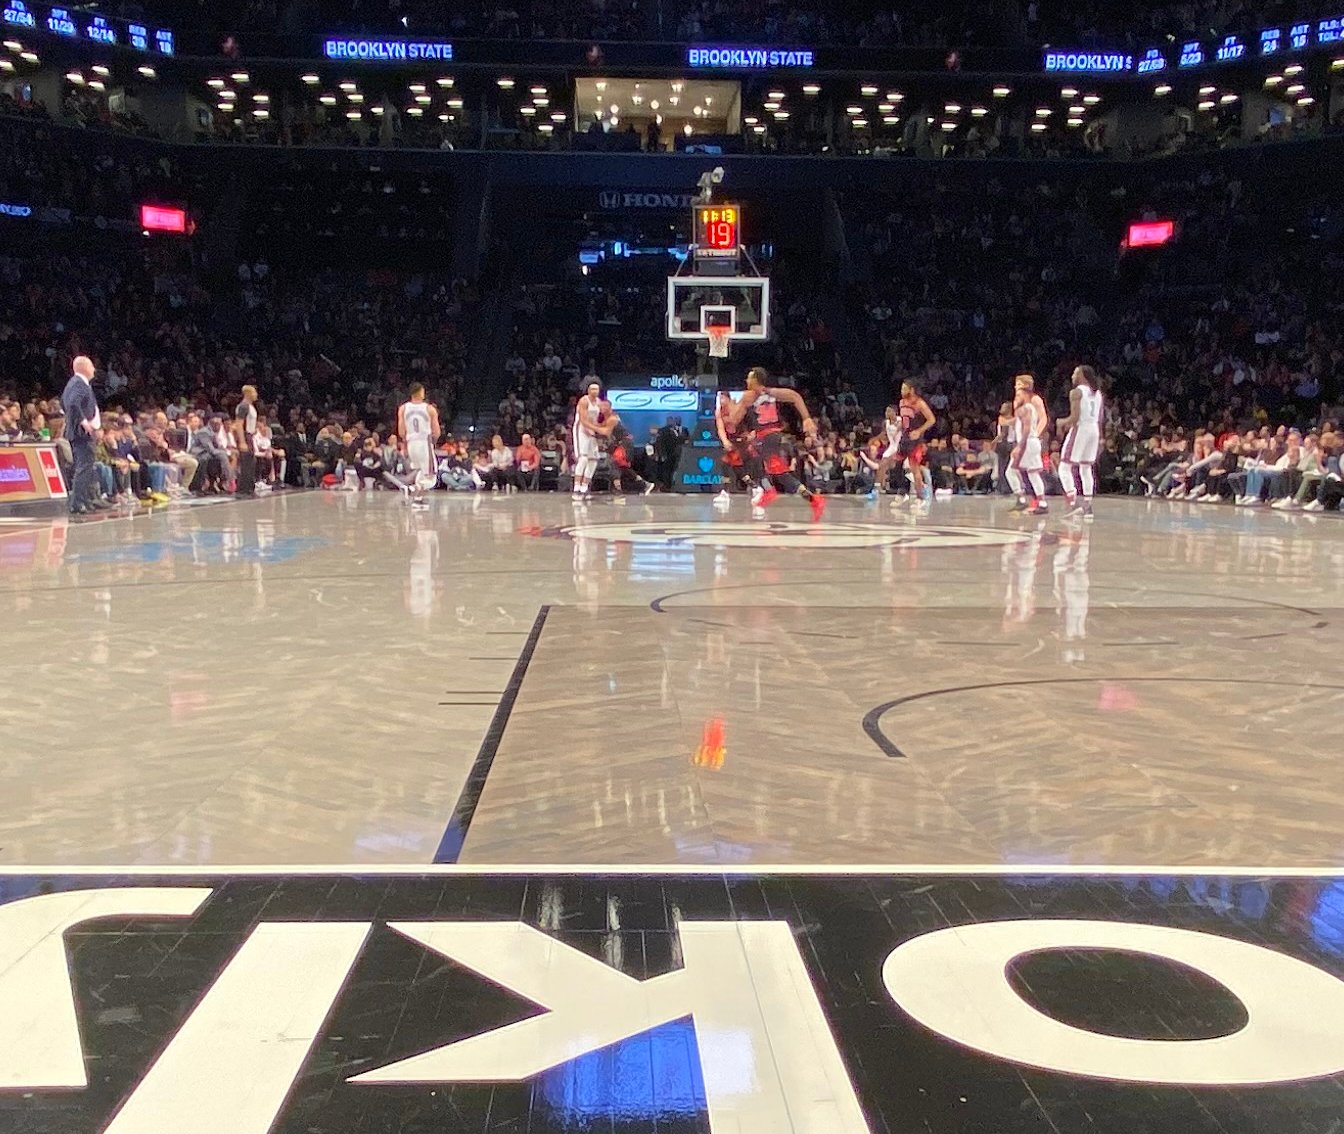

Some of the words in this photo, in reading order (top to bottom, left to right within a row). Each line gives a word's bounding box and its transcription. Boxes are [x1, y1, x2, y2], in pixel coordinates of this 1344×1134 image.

[326, 41, 406, 58] BROOKLYN
[408, 44, 453, 59] STATE
[689, 49, 767, 65] BROOKLYN
[769, 51, 813, 66] STATE
[1218, 45, 1244, 59] 11/17
[1045, 54, 1124, 70] BROOKLYN
[711, 223, 731, 246] 19
[683, 474, 723, 484] BARCLAY
